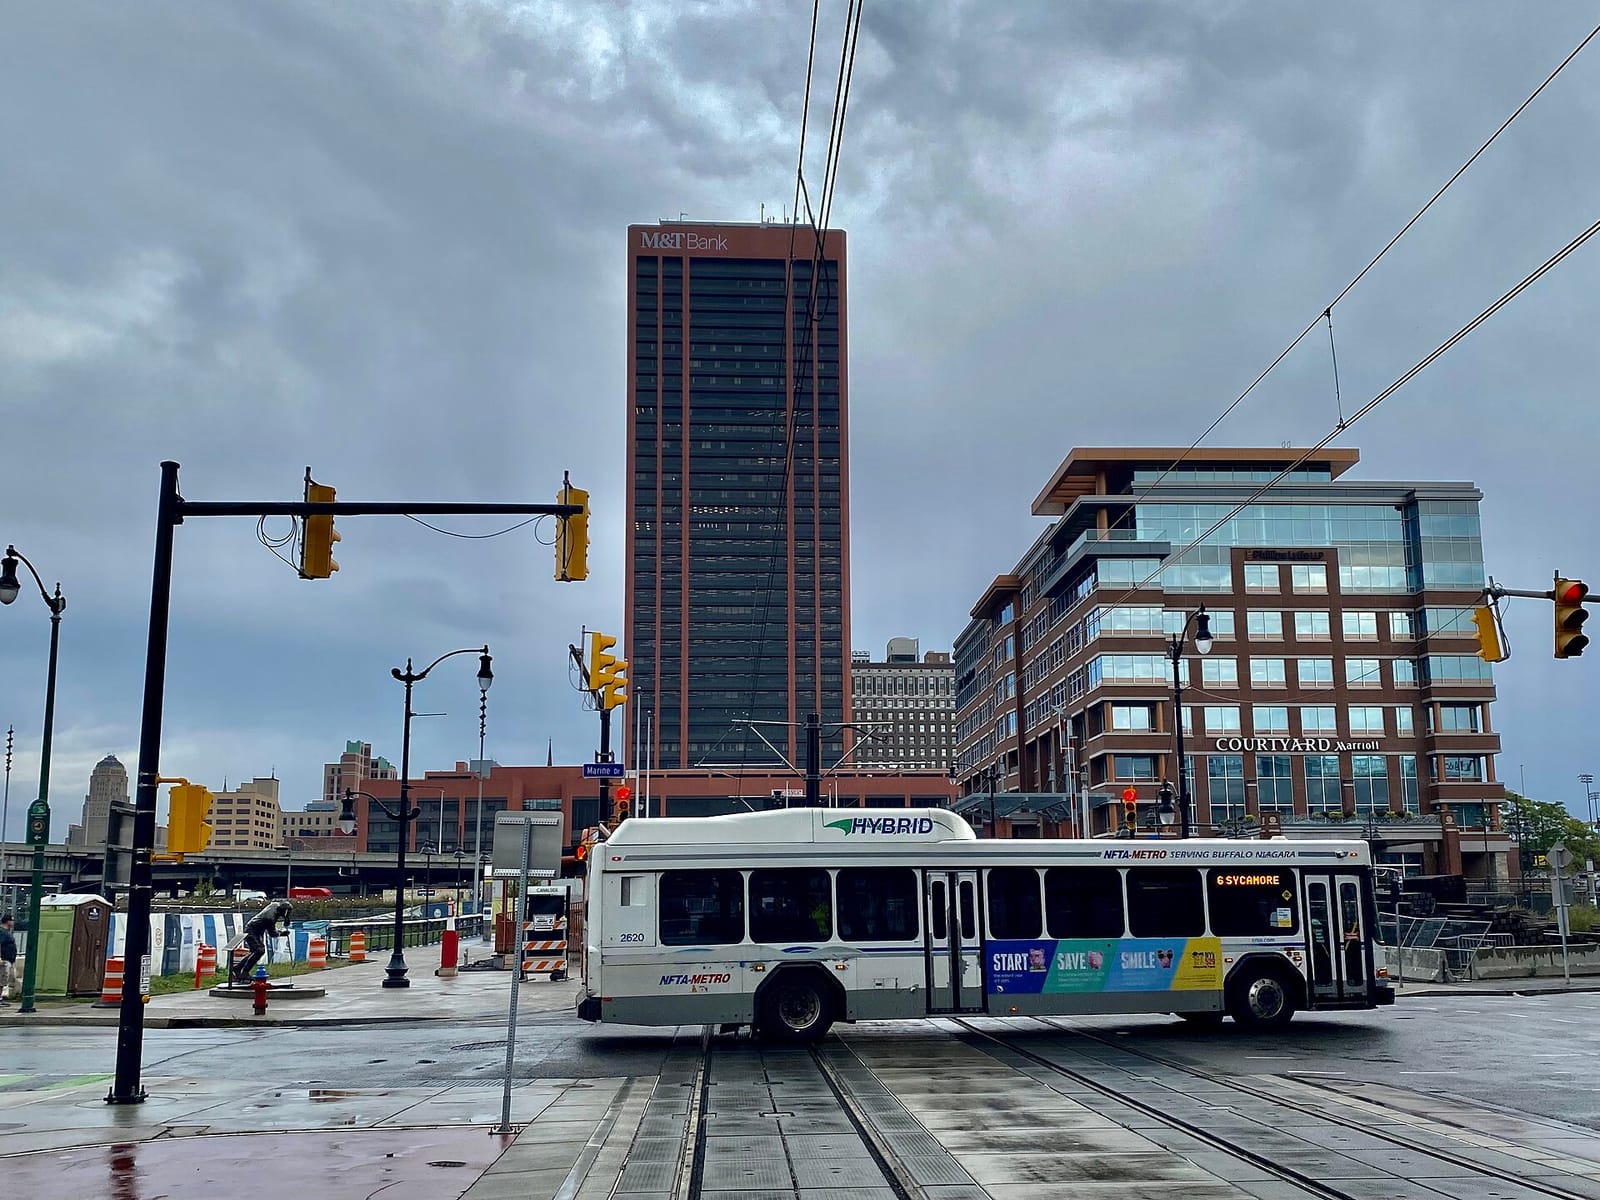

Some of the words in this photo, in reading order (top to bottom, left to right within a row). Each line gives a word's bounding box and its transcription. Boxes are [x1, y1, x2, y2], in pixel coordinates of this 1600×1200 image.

[640, 232, 685, 249] M&T
[687, 232, 728, 250] Bank
[1216, 738, 1331, 751] COURTYARD
[1334, 741, 1380, 752] Marriott
[587, 766, 610, 775] Marine
[851, 817, 933, 835] HYBRID
[1103, 850, 1167, 859] NFTA-METRO
[1169, 850, 1209, 859] SERVING
[1212, 850, 1253, 859] BUFFALO
[1255, 850, 1296, 859] NIAGARA
[1216, 875, 1224, 885] 6
[1225, 875, 1280, 885] SYCAMORE
[620, 933, 645, 942] 2620
[993, 953, 1028, 971] START
[1057, 953, 1087, 970] SAVE
[1121, 952, 1156, 969] SMILE
[659, 973, 731, 985] NFTA-METRO
